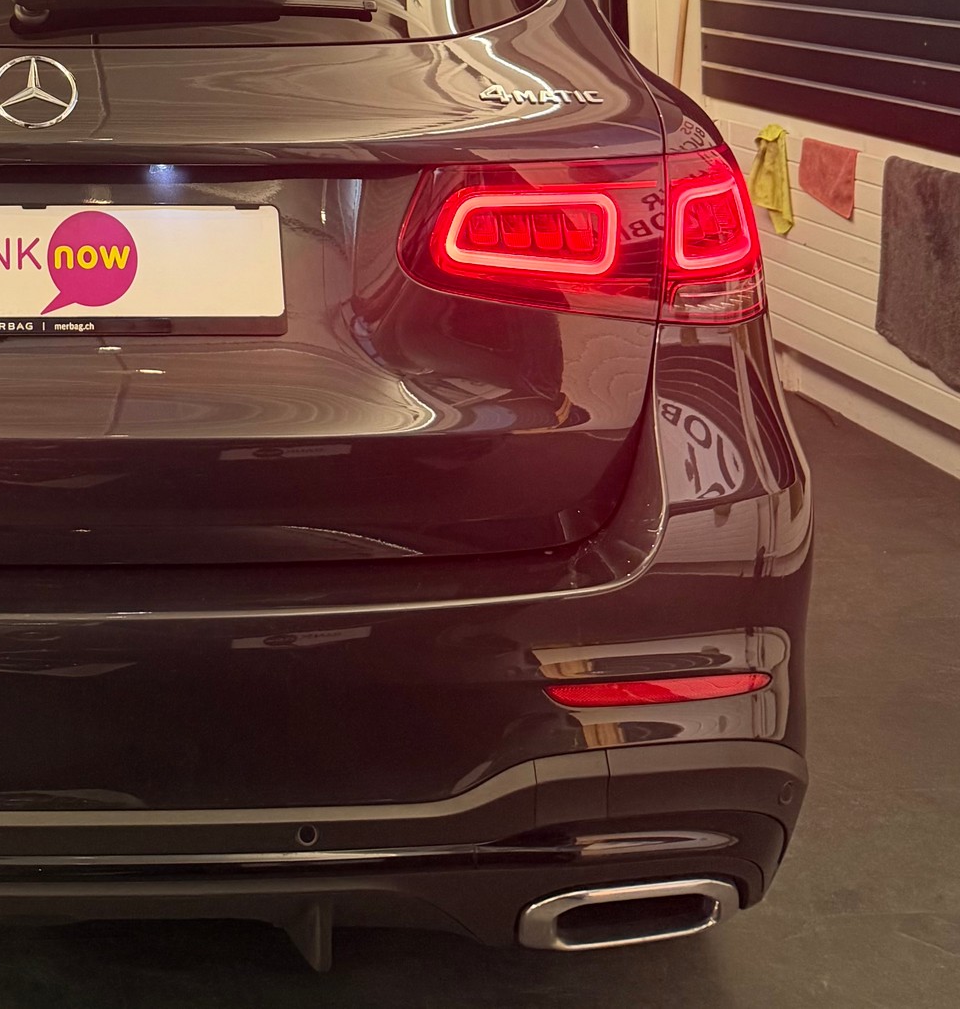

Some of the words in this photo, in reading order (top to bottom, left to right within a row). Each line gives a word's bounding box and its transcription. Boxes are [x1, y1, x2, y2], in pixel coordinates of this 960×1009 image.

[480, 84, 604, 105] 4MATIC
[53, 243, 131, 271] now
[54, 321, 95, 332] merbag.ch
